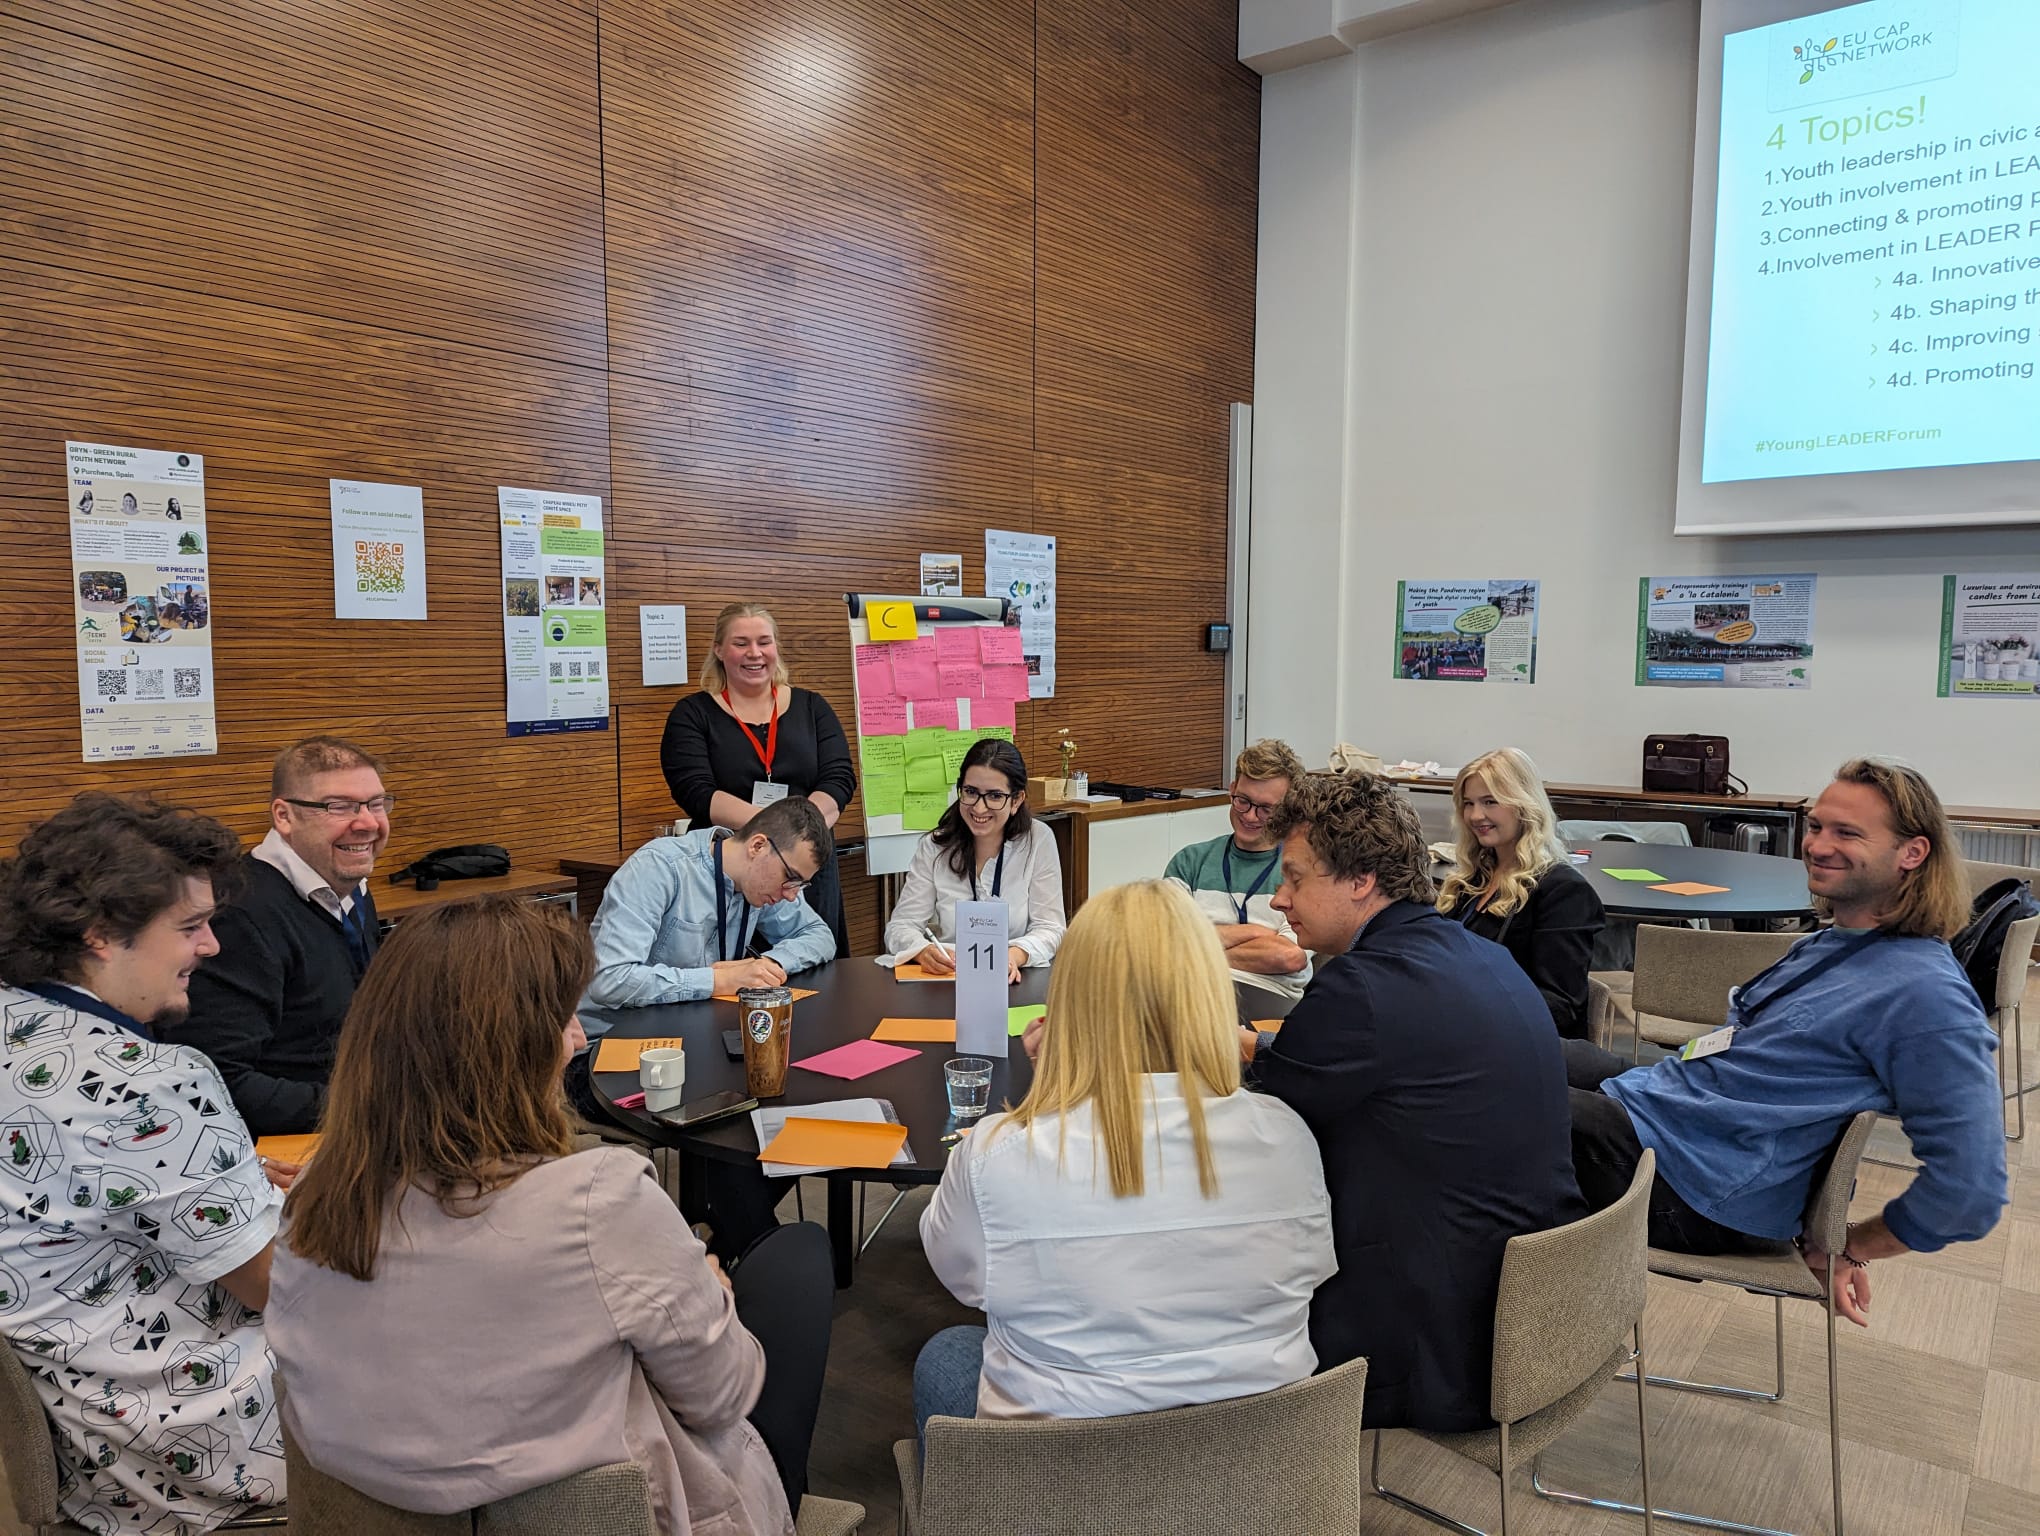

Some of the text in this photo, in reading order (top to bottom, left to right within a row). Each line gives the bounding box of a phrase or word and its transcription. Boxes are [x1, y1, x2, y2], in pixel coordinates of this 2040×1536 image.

[1841, 31, 1935, 64] NETWORK
[1843, 21, 1910, 48] EU CAP
[1766, 95, 1928, 152] 4 Topics!
[1764, 159, 1834, 186] 1.Youth
[1841, 140, 1947, 173] leadership
[1953, 136, 1972, 152] in
[1979, 125, 2028, 148] civic
[1761, 191, 1833, 217] 2.Youth
[1839, 171, 1962, 205] involvement
[1969, 165, 1987, 182] in
[1759, 213, 1888, 246] 3.Connecting
[1895, 208, 1909, 224] &
[1916, 193, 2023, 227] promoting
[1758, 242, 1895, 276] 4.Involvement
[1900, 238, 1917, 255] in
[1925, 222, 2020, 252] LEADER
[1892, 255, 2040, 287] 4a. Innovative
[1890, 304, 1922, 321] 4b.
[1929, 293, 2017, 317] Shaping
[1888, 325, 2031, 354] 4c. Improving
[1886, 360, 2034, 388] 4d. Promoting
[1755, 426, 1942, 453] #YoungLEADERForum
[71, 455, 127, 466] YOUTH NETWORK
[93, 449, 115, 457] GREEN
[116, 451, 138, 459] RURAL
[81, 468, 135, 479] Purchena, Spain
[1408, 586, 1427, 594] Making
[1468, 586, 1486, 595] region
[1671, 582, 1749, 590] Entrepreneurship trainings
[1700, 590, 1740, 598] Catalonia
[2006, 592, 2028, 600] from
[881, 607, 898, 629] C
[1422, 600, 1438, 609] youth
[967, 942, 994, 971] 11
